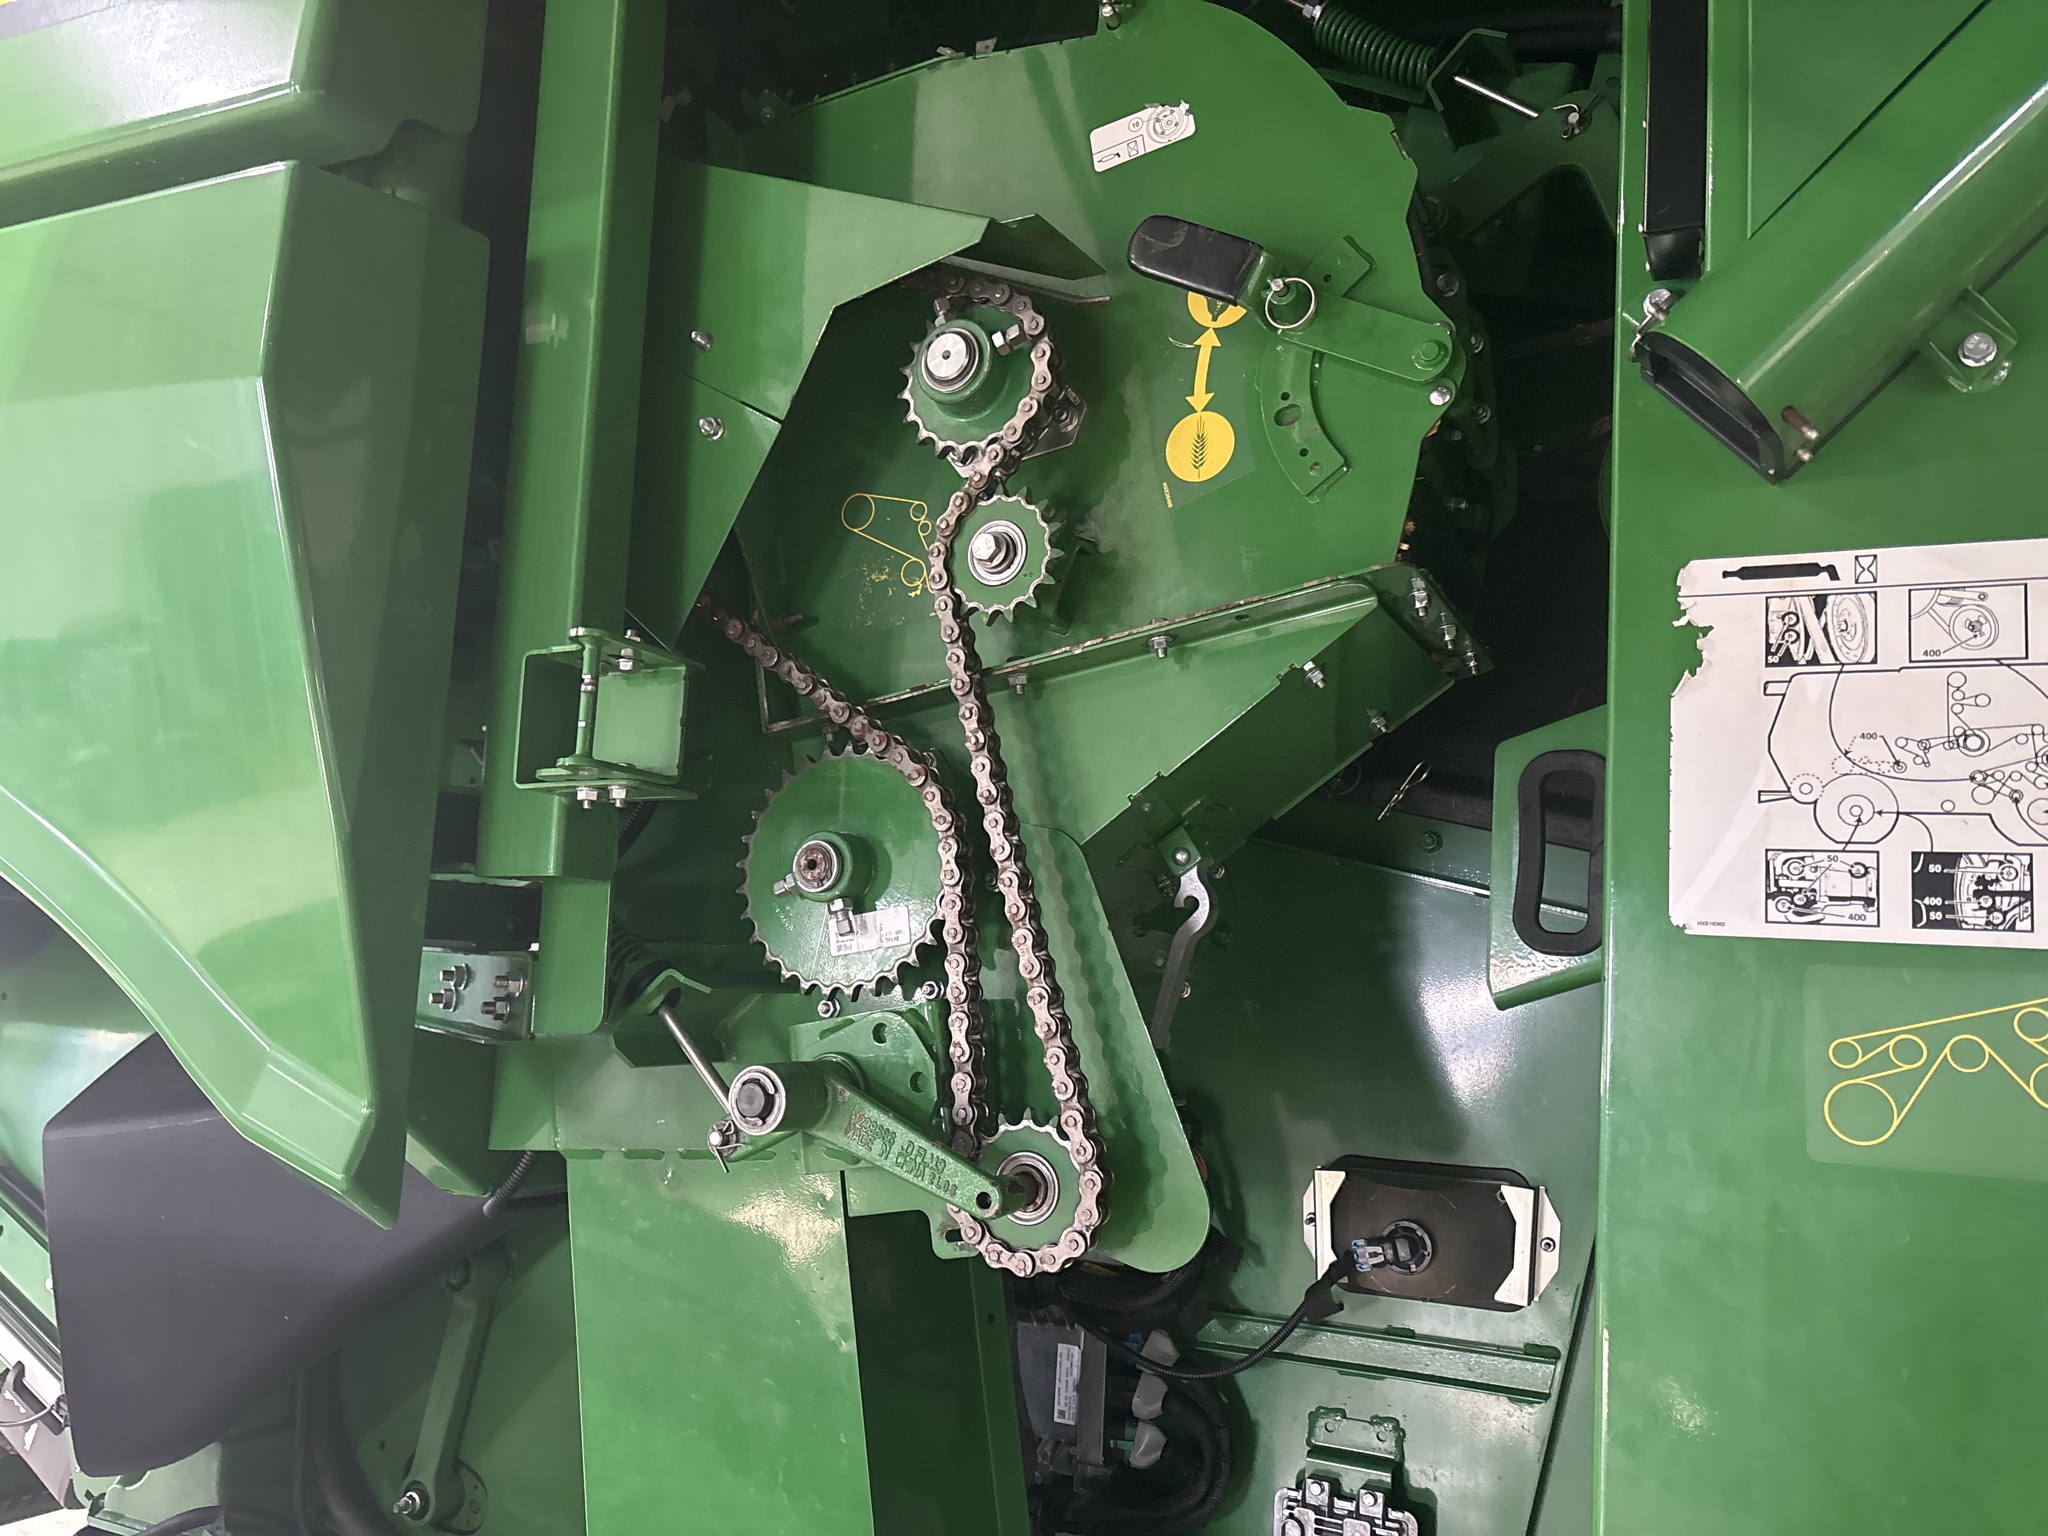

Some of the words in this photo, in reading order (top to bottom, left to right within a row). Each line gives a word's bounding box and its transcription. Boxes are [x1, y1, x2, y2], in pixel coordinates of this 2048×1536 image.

[1922, 649, 1941, 657] 400
[1767, 656, 1780, 664] 50
[1859, 732, 1878, 740] 400
[1827, 855, 1839, 863] 50
[1928, 864, 1942, 873] 50
[1923, 897, 1942, 906] 400
[1848, 913, 1867, 922] 400
[1929, 911, 1943, 920] 50
